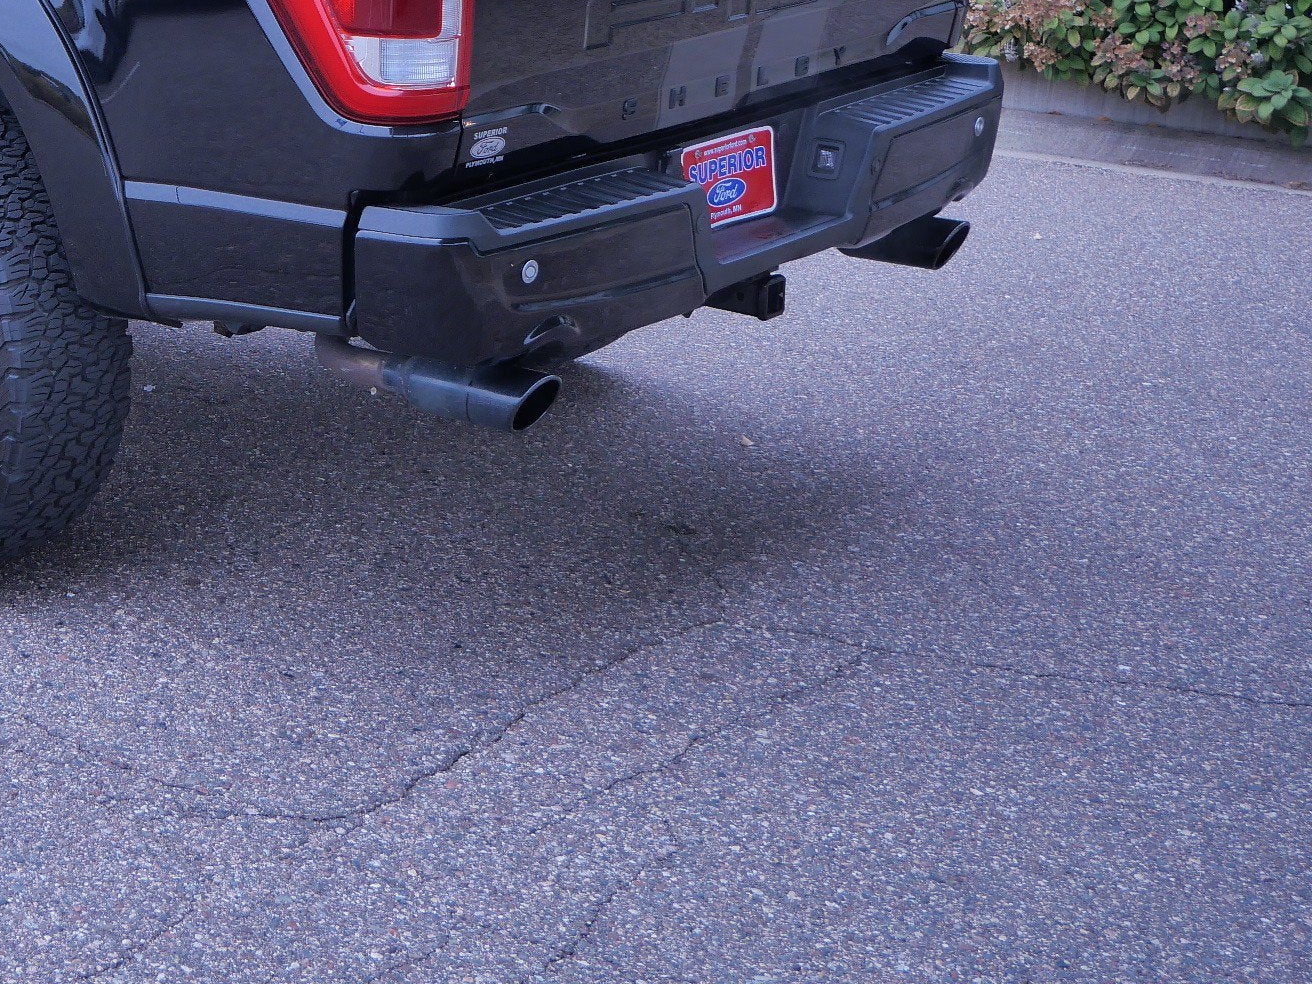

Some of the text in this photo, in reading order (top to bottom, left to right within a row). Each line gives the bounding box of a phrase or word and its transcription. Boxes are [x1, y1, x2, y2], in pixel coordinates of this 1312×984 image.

[473, 126, 508, 140] SUPERIOR
[689, 145, 766, 185] SUPERIOR
[713, 181, 738, 203] Ford
